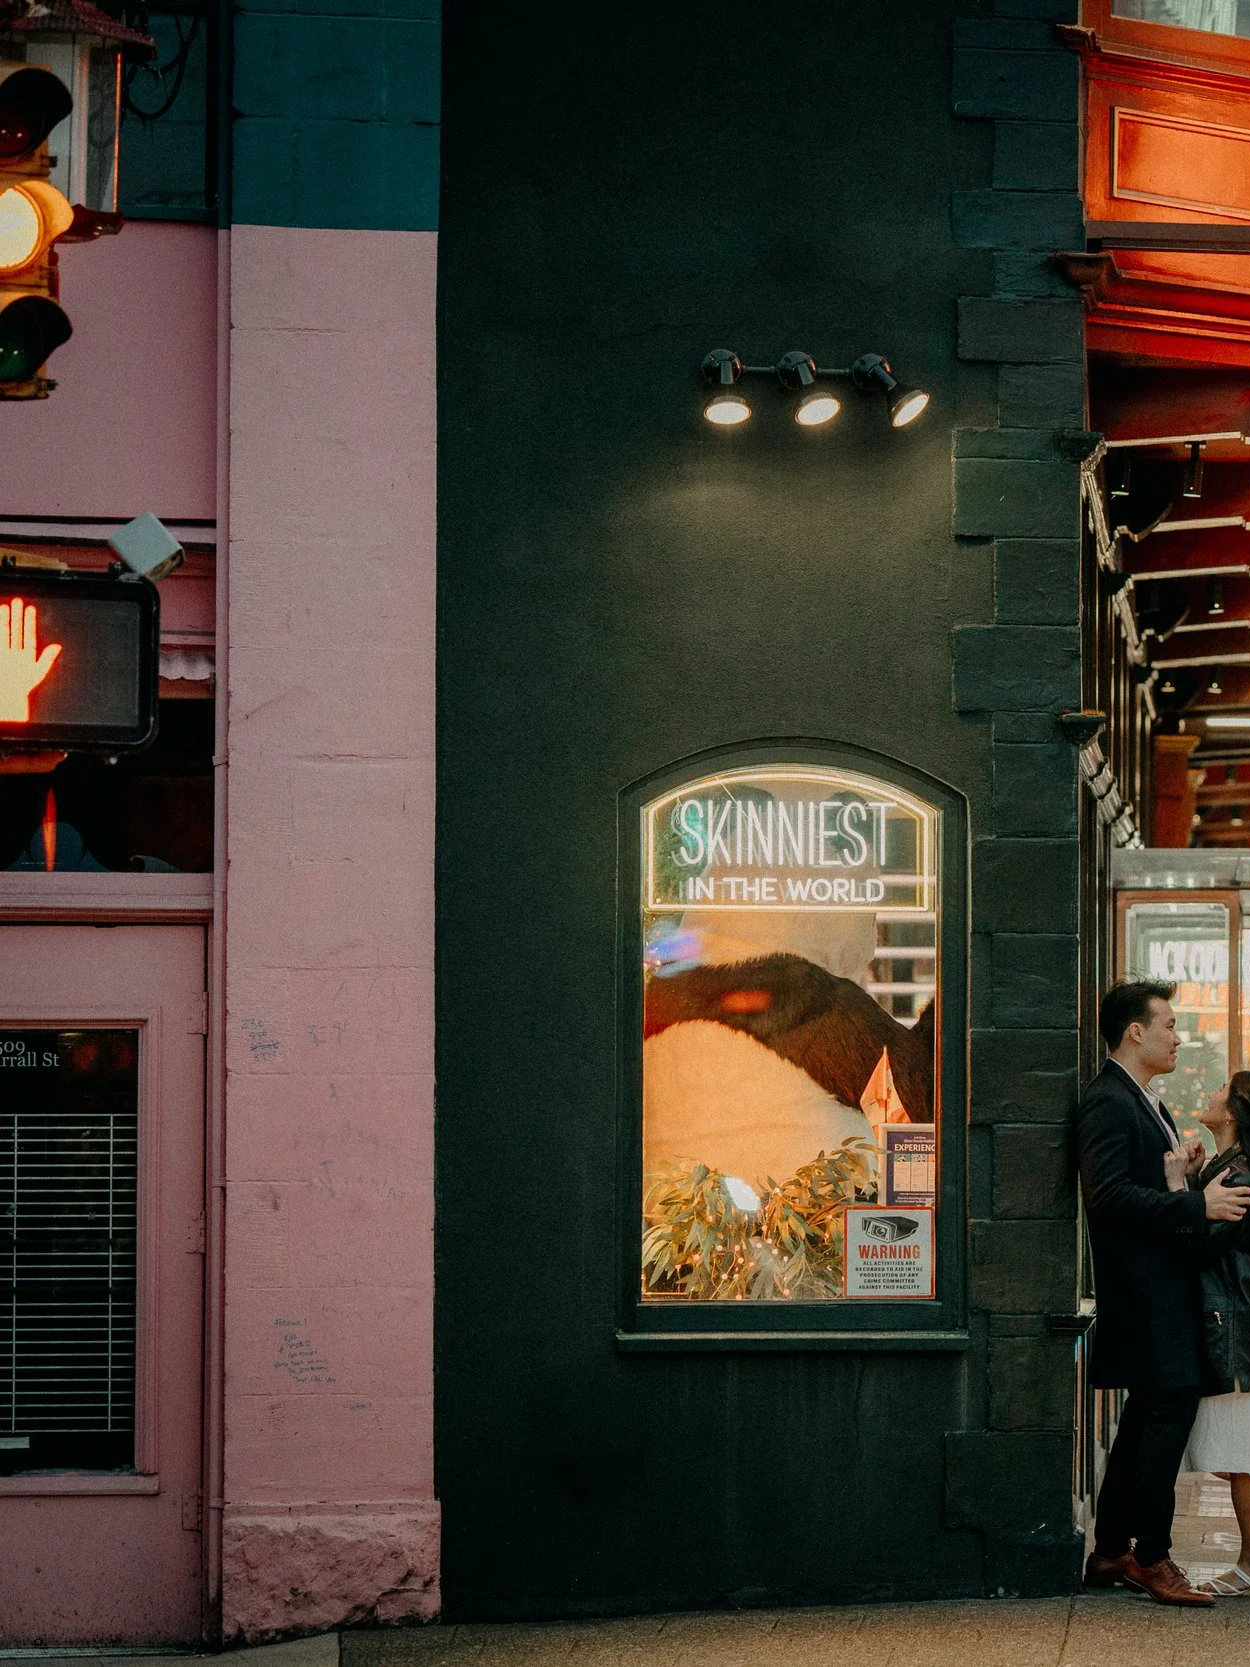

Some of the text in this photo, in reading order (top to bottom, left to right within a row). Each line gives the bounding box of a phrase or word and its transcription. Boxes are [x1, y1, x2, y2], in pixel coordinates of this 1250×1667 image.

[679, 799, 898, 867] SKINNIEST
[687, 876, 885, 902] IN THE WORLD
[0, 1051, 60, 1067] rrall St
[858, 1244, 921, 1259] WARNING
